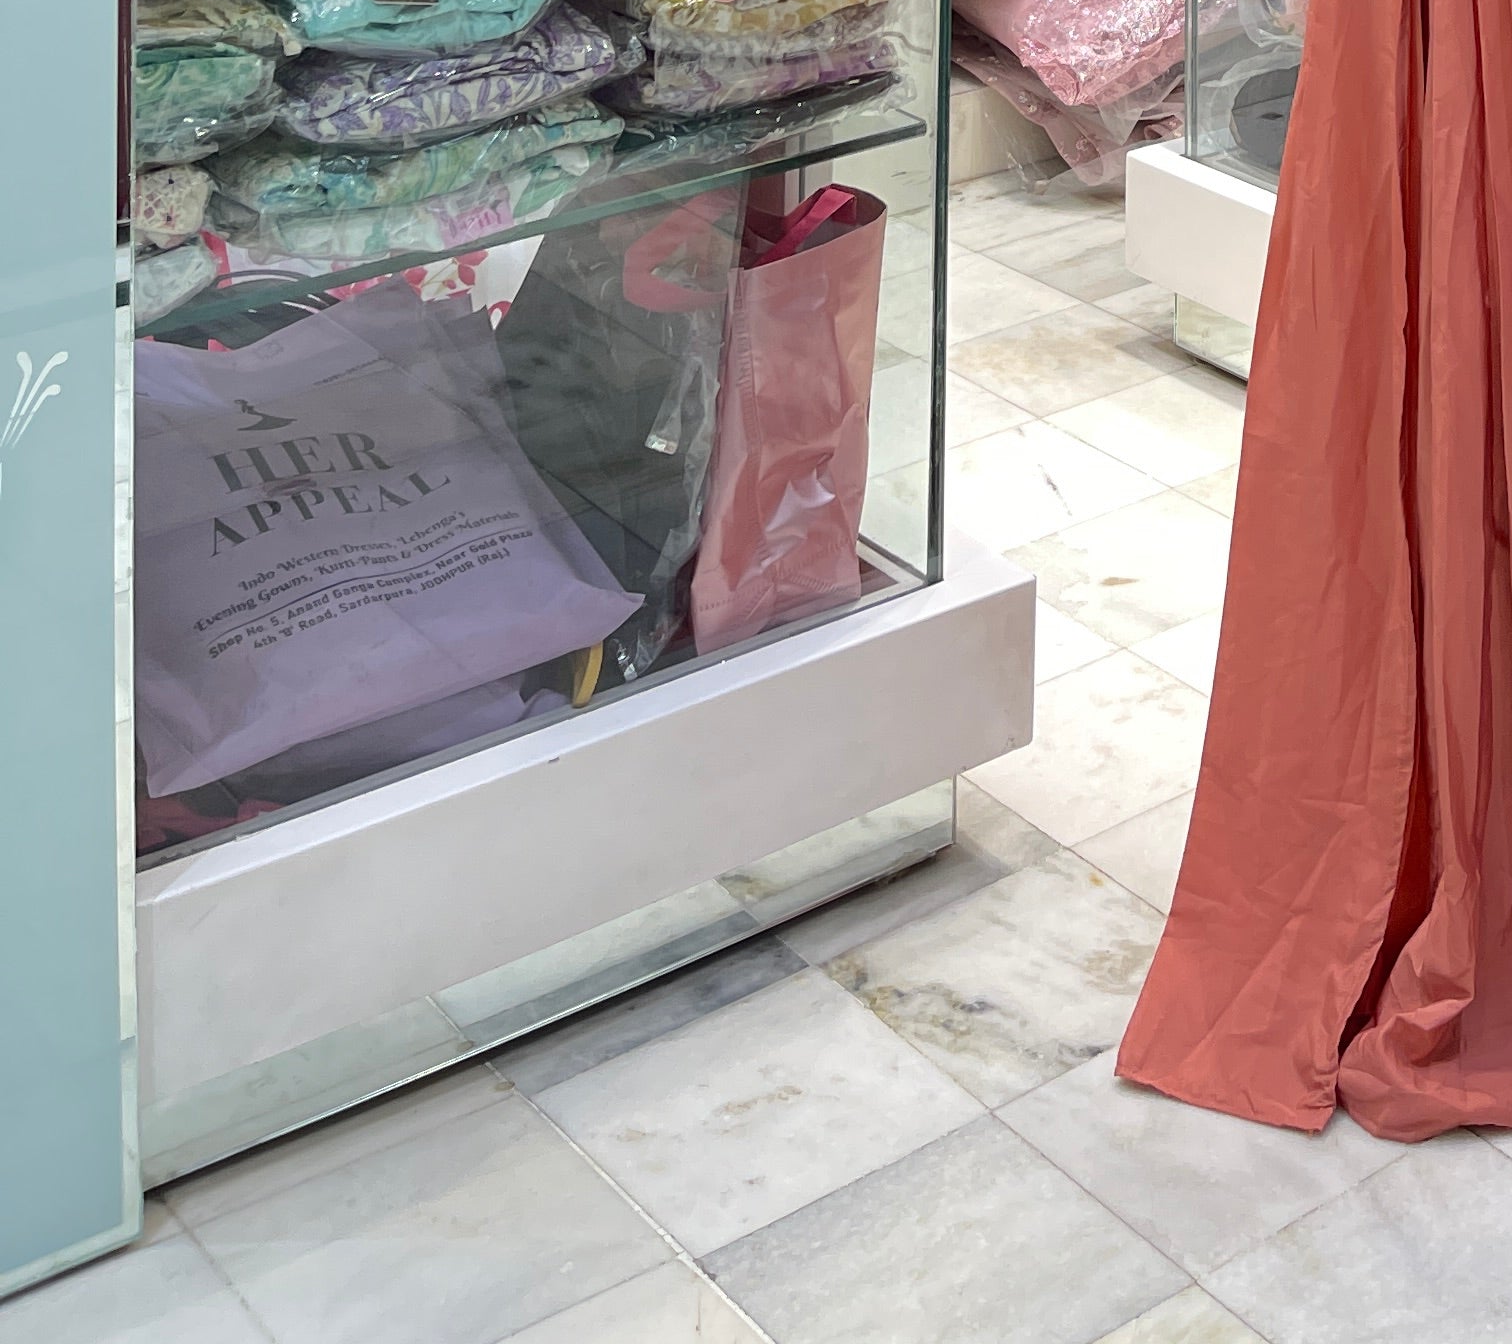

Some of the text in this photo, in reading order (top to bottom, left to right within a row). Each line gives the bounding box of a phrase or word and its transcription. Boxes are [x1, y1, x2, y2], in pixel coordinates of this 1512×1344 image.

[207, 431, 395, 495] HER
[209, 471, 451, 558] APPEAL
[193, 598, 258, 632] Evening
[258, 574, 314, 603] Gowns,
[455, 511, 521, 533] Materials
[208, 632, 244, 659] Shop
[287, 593, 330, 620] Anand
[332, 582, 376, 599] Ganga
[435, 551, 467, 570] Near
[468, 539, 498, 554] Gold
[238, 570, 276, 591] Indo
[276, 547, 340, 572] Western
[253, 635, 278, 649] 4th
[420, 561, 475, 591] JODHPUR
